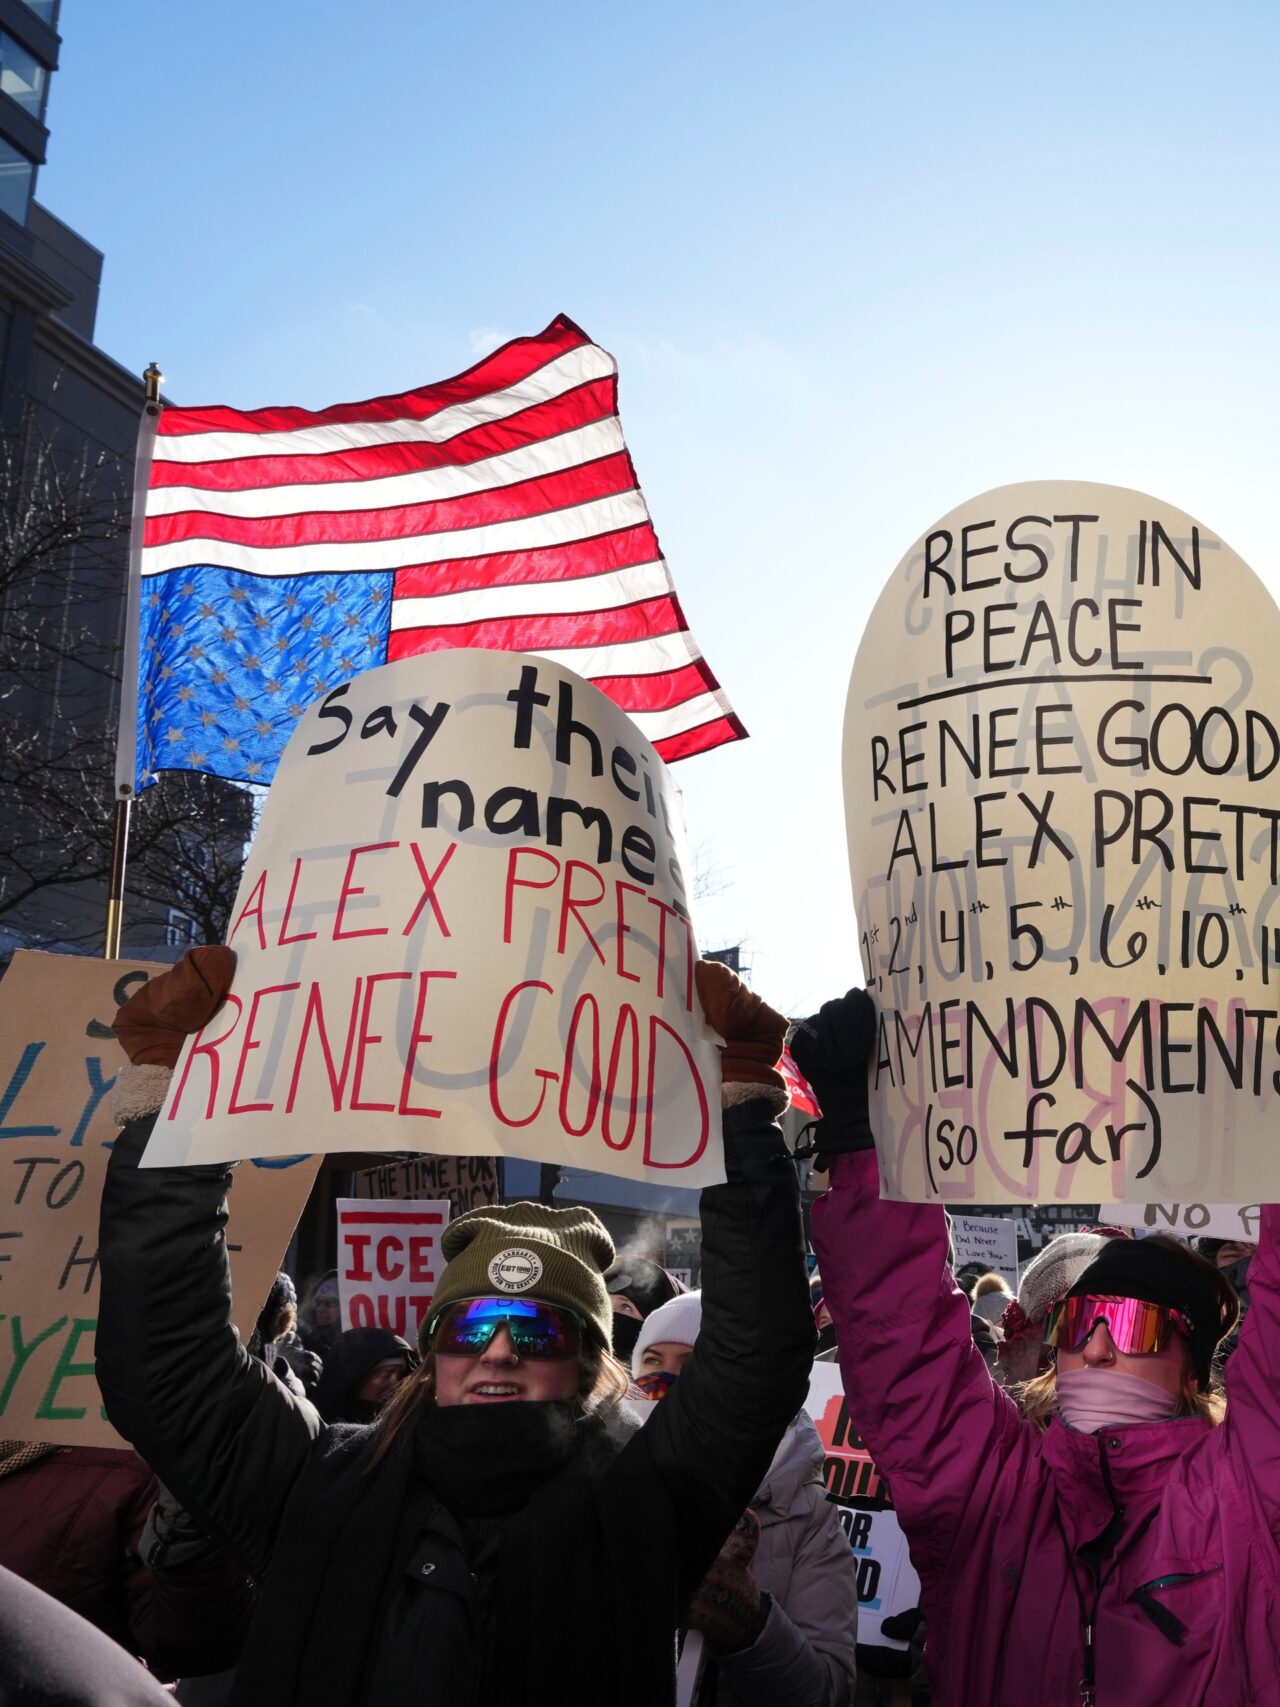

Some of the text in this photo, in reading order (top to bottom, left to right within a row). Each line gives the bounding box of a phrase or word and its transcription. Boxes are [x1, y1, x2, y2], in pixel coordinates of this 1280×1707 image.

[923, 514, 1202, 598] REST IN
[945, 598, 1145, 679] PEACE
[307, 683, 450, 798] Say
[871, 700, 1280, 802] RENEE GOOD
[887, 790, 1075, 881] ALEX
[231, 841, 457, 950] ALEX
[168, 970, 710, 1169] RENEE GOOD
[925, 1079, 1161, 1193] (so far)
[13, 1157, 85, 1209] TO
[364, 1156, 495, 1200] THE TIME FOR
[963, 1220, 999, 1234] Because
[974, 1236, 997, 1246] Never
[1144, 1203, 1211, 1229] NO
[344, 1234, 435, 1283] ICE
[503, 1251, 535, 1260] CARHARTT
[956, 1248, 962, 1256] I
[966, 1249, 986, 1258] Love
[349, 1293, 433, 1337] OUT
